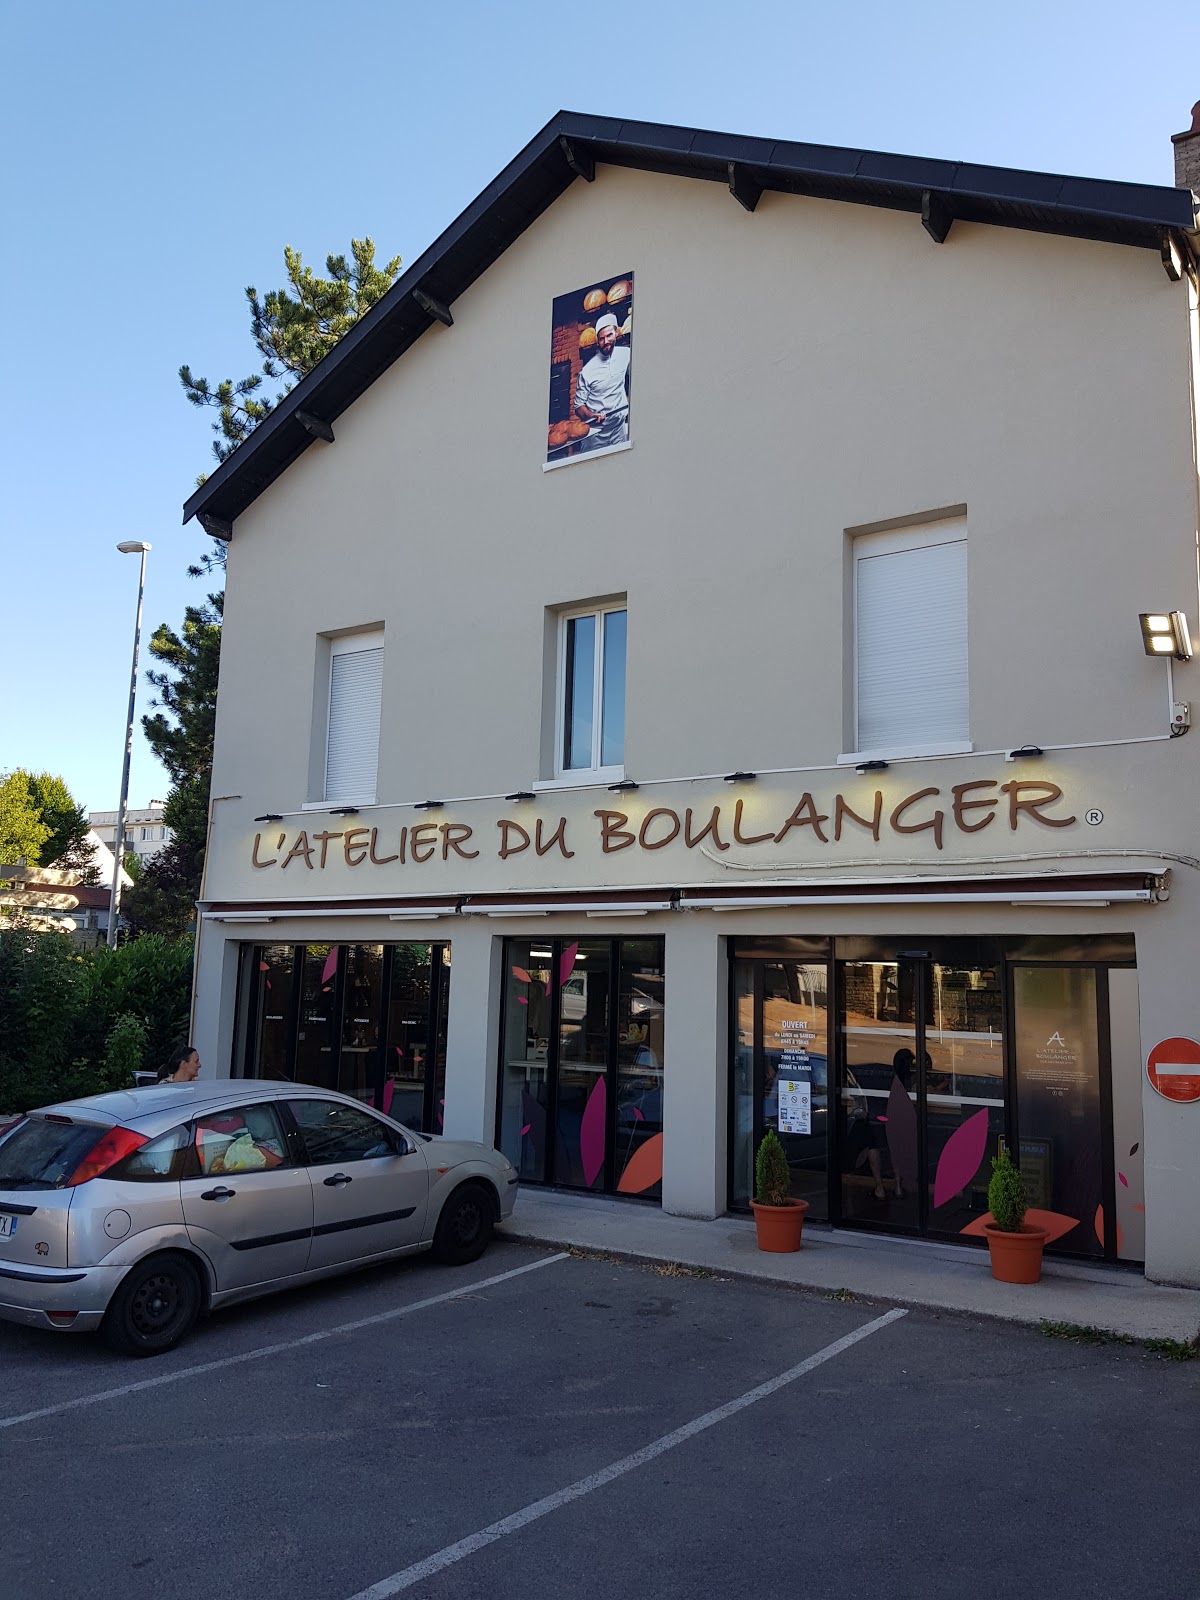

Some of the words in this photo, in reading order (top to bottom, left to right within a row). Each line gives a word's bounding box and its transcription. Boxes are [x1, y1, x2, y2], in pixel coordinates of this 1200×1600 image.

[252, 822, 480, 869] L'ATELIER
[497, 816, 575, 860] DU
[594, 779, 1076, 853] BOULANGER
[782, 1020, 808, 1029] OUVERT
[1046, 1031, 1065, 1047] A
